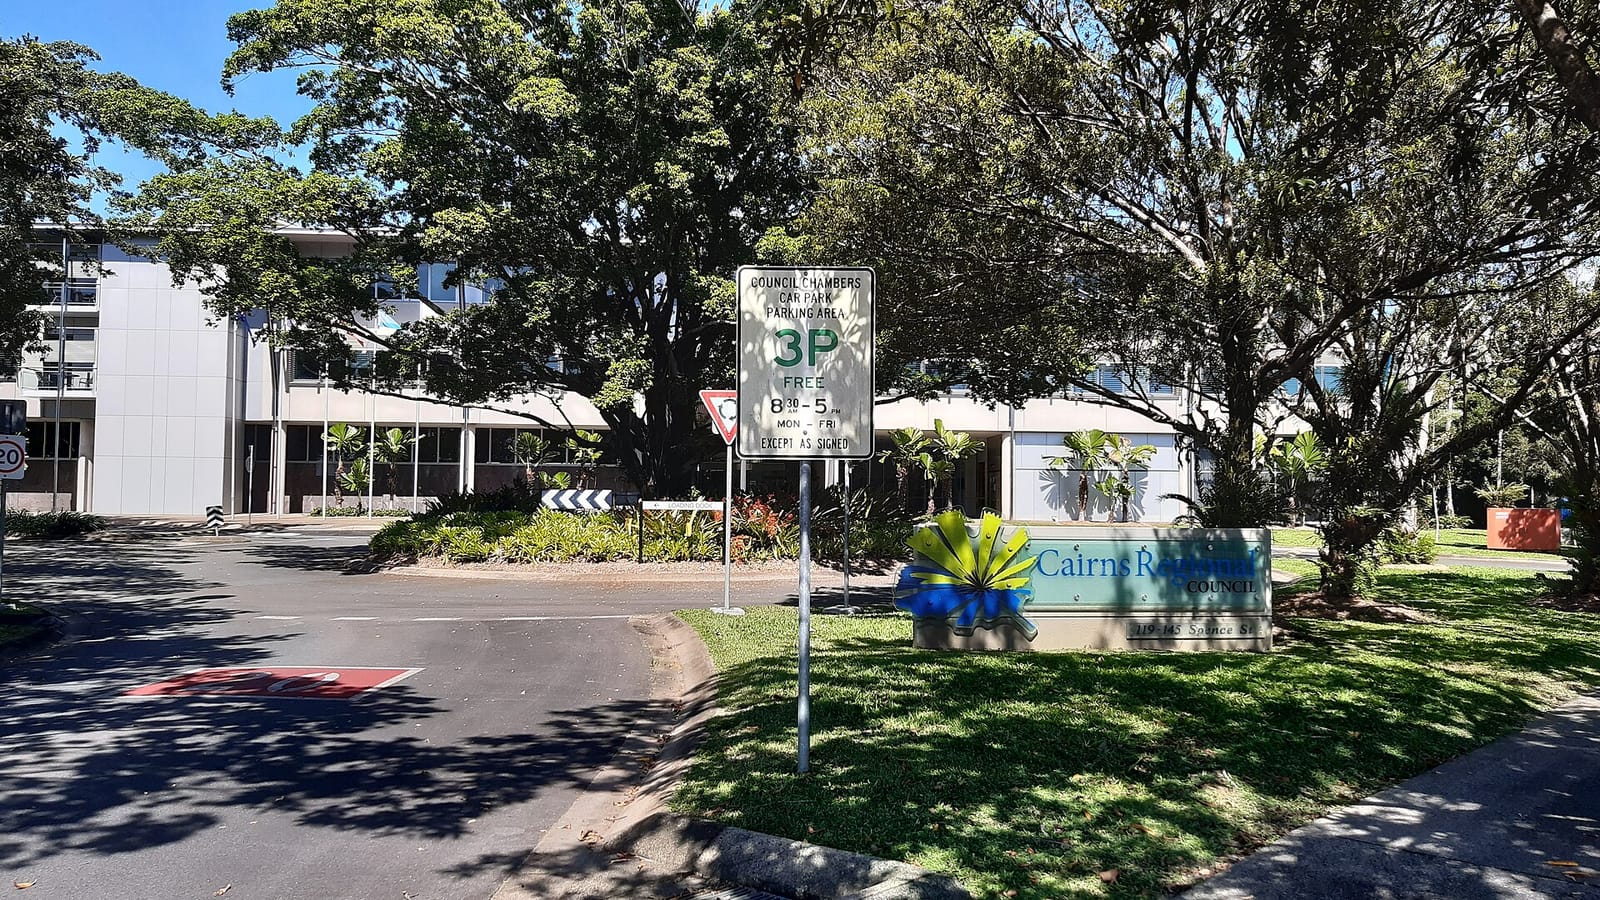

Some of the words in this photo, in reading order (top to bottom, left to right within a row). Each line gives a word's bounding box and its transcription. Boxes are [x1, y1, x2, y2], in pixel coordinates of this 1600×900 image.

[751, 277, 799, 289] COUNCIL
[802, 277, 861, 289] CHAMBERS
[779, 292, 801, 304] CAR
[804, 292, 832, 304] PARK
[767, 307, 814, 319] PARKING
[816, 307, 845, 319] AREA
[773, 328, 839, 368] 3P
[783, 376, 825, 389] FREE
[777, 420, 800, 429] MON
[819, 420, 836, 429] FRI
[761, 438, 793, 450] EXCEPT
[800, 438, 812, 450] AS
[817, 438, 848, 450] SIGNED
[1037, 549, 1131, 577] Cairns
[1134, 549, 1256, 587] Regional
[1187, 580, 1257, 593] COUNCIL
[1135, 624, 1182, 635] 119-145
[1189, 624, 1233, 636] Spence
